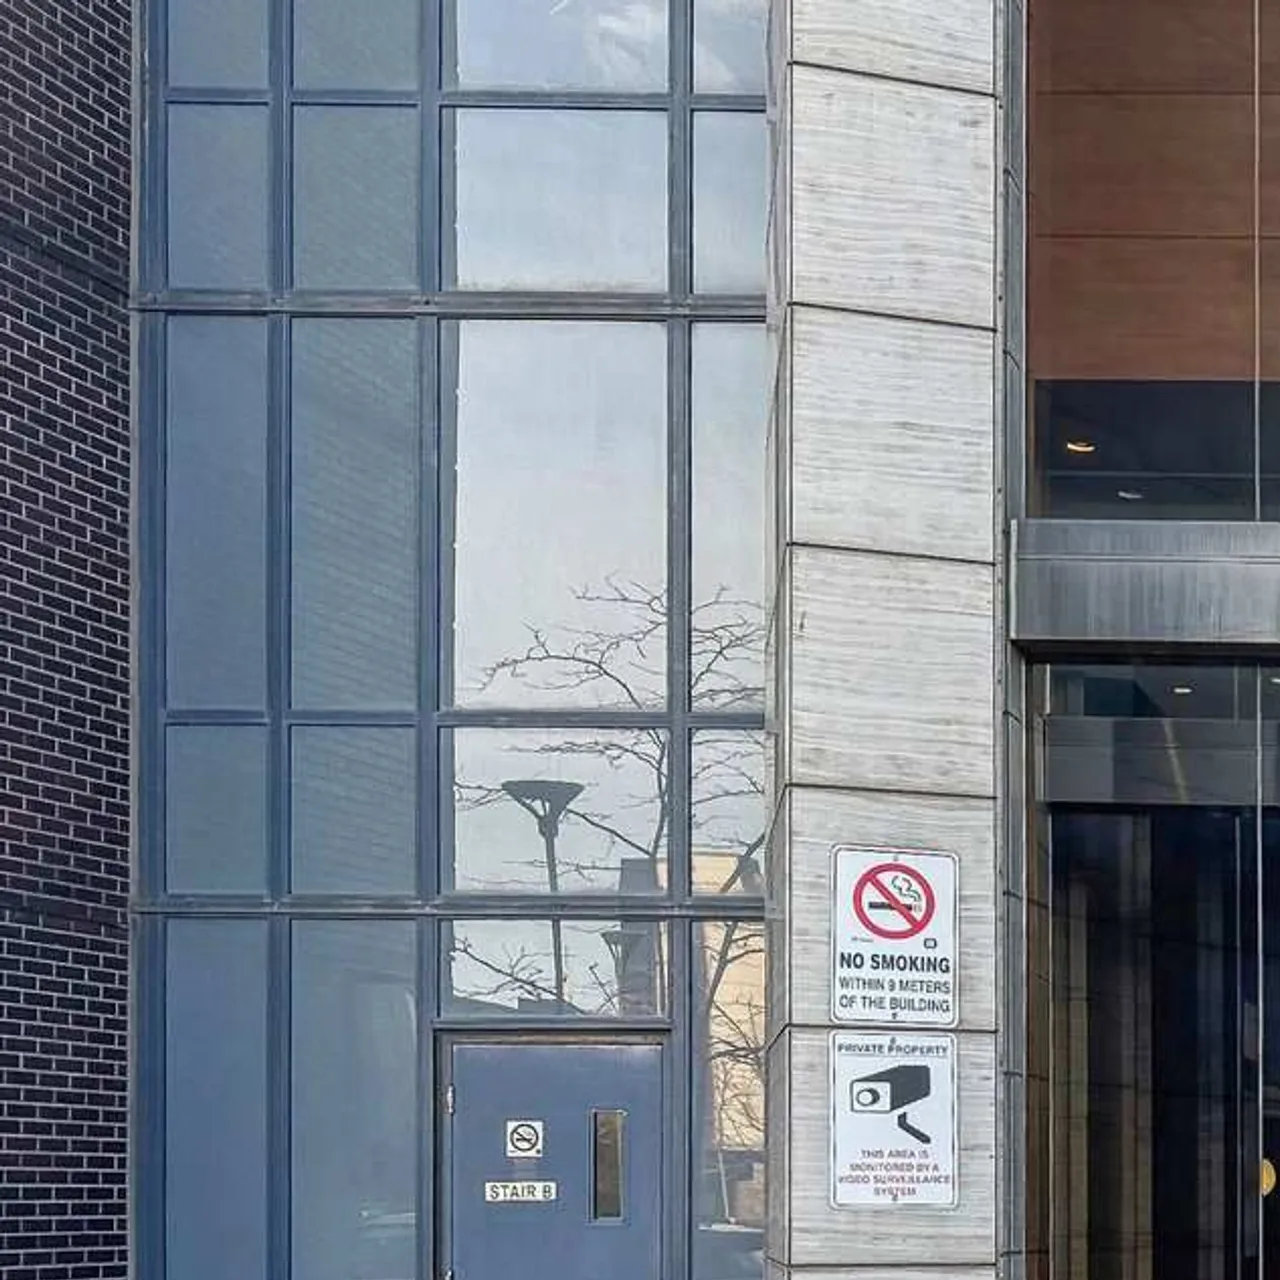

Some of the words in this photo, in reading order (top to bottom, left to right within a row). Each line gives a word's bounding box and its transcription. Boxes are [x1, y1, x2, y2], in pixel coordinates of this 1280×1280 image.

[840, 952, 864, 969] NO
[870, 953, 951, 973] SMOKING
[839, 977, 885, 990] WITHIN
[899, 979, 951, 994] METERS
[840, 994, 857, 1008] OF
[861, 996, 886, 1010] THE
[889, 997, 950, 1013] BUILDING
[837, 1043, 884, 1053] PRIVATE
[887, 1044, 949, 1054] PROPERTY
[489, 1184, 537, 1199] STAIR
